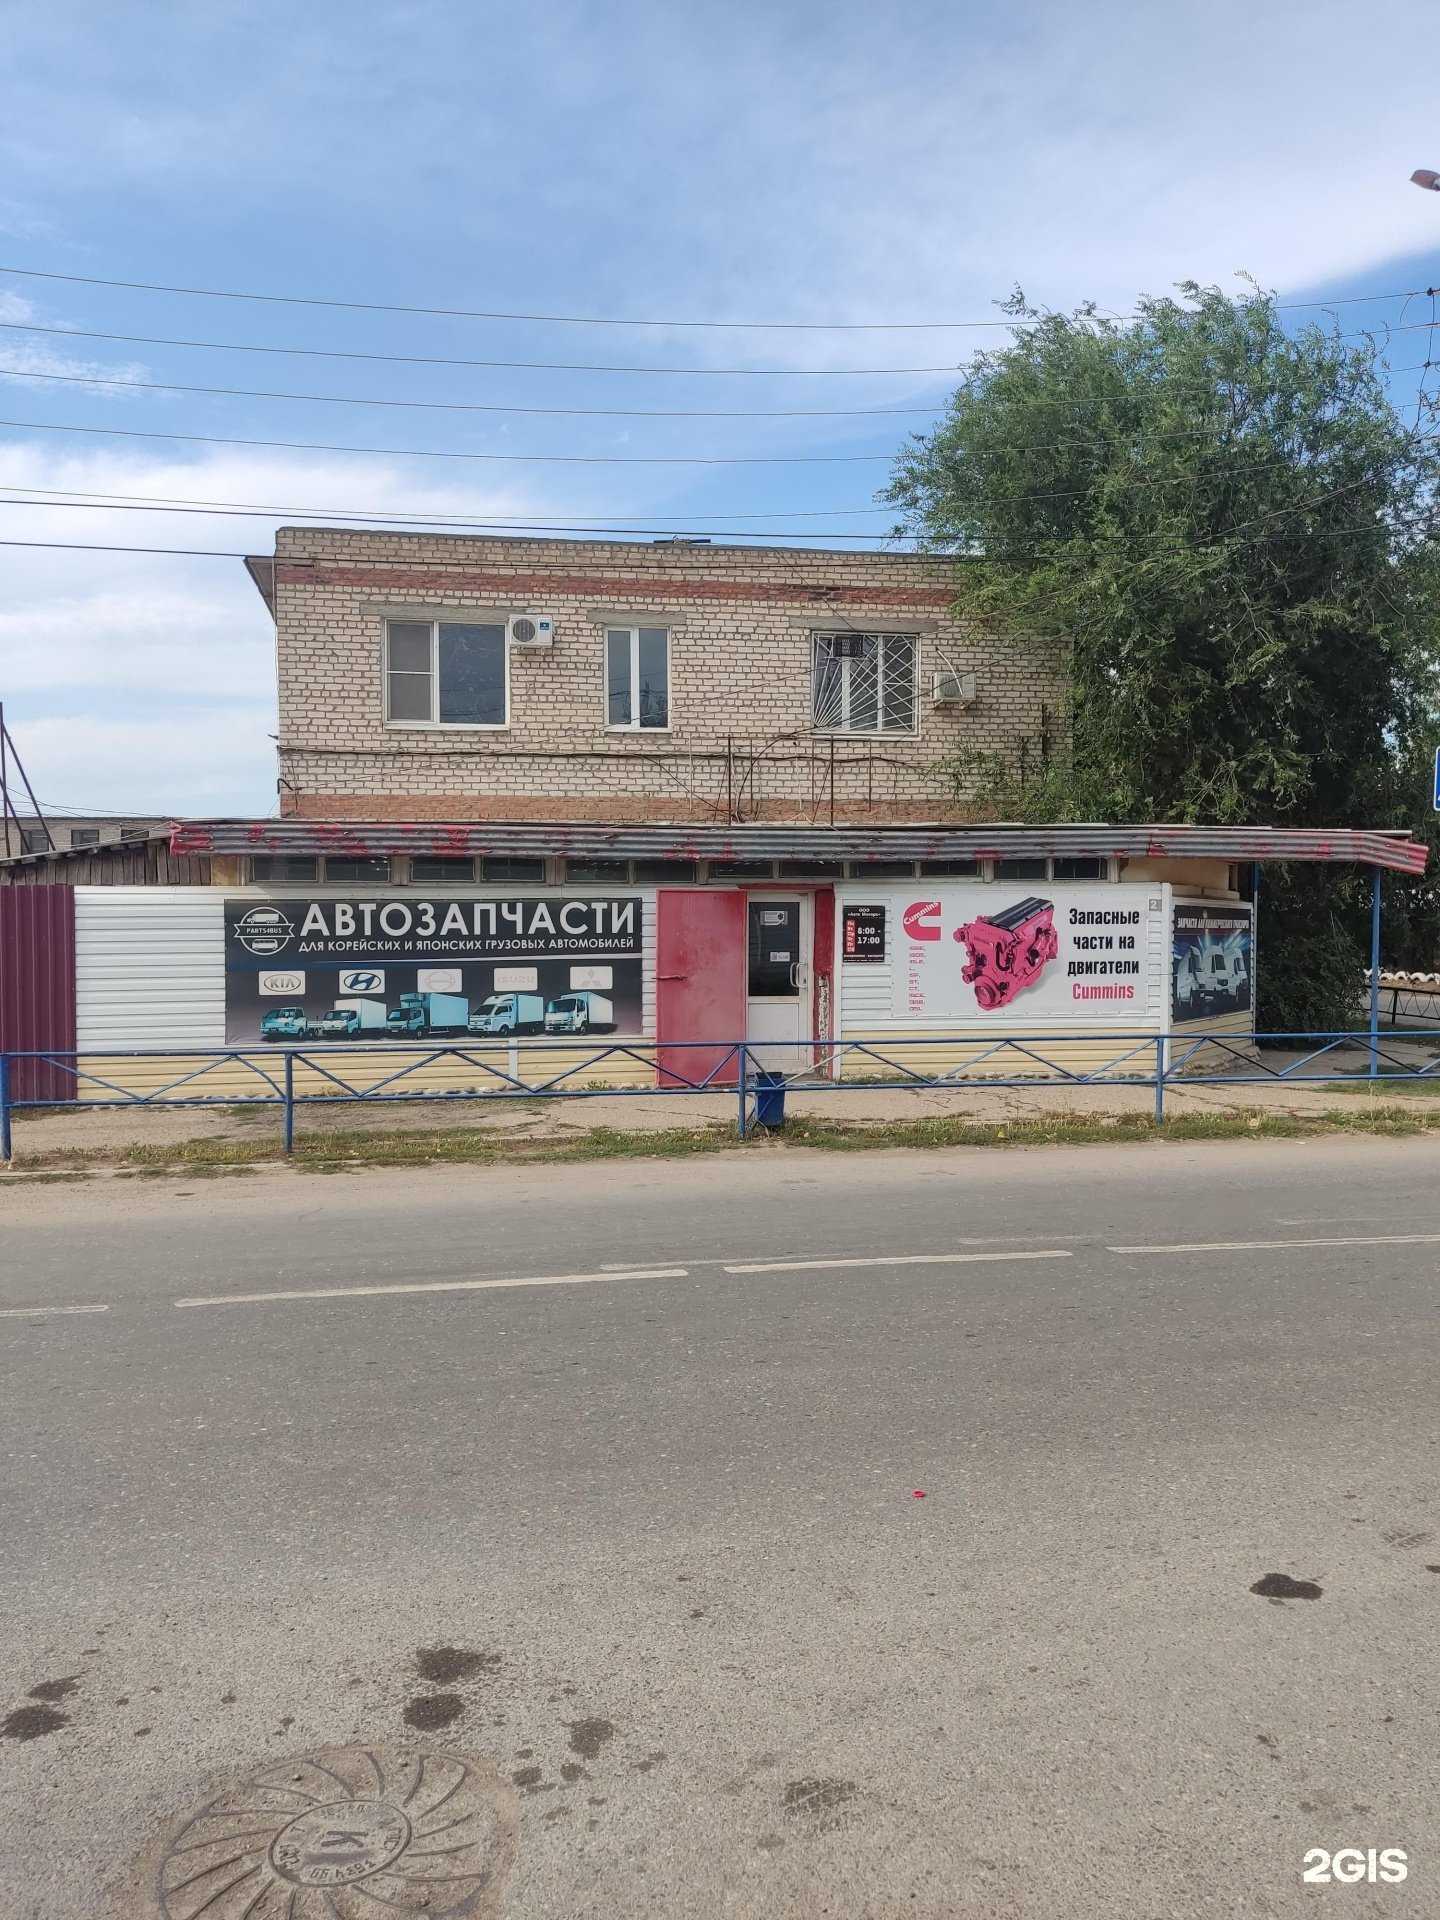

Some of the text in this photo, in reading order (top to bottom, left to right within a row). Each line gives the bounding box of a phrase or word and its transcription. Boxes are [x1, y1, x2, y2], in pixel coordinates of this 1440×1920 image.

[300, 902, 634, 937] АВТОЗАПЧАСТИ
[903, 901, 940, 925] Cummins
[1069, 908, 1140, 925] Запасные
[299, 936, 634, 952] ДЛЯ КОРЕЙСКИХ И ЯПОНСКИХ ГРУЗОВЫХ АВТОМОБИЛЕЙ
[857, 936, 880, 944] 17:00
[1073, 935, 1135, 950] части на
[1067, 960, 1139, 977] двигатели
[269, 976, 296, 988] KIA
[1072, 982, 1135, 1000] Cummins
